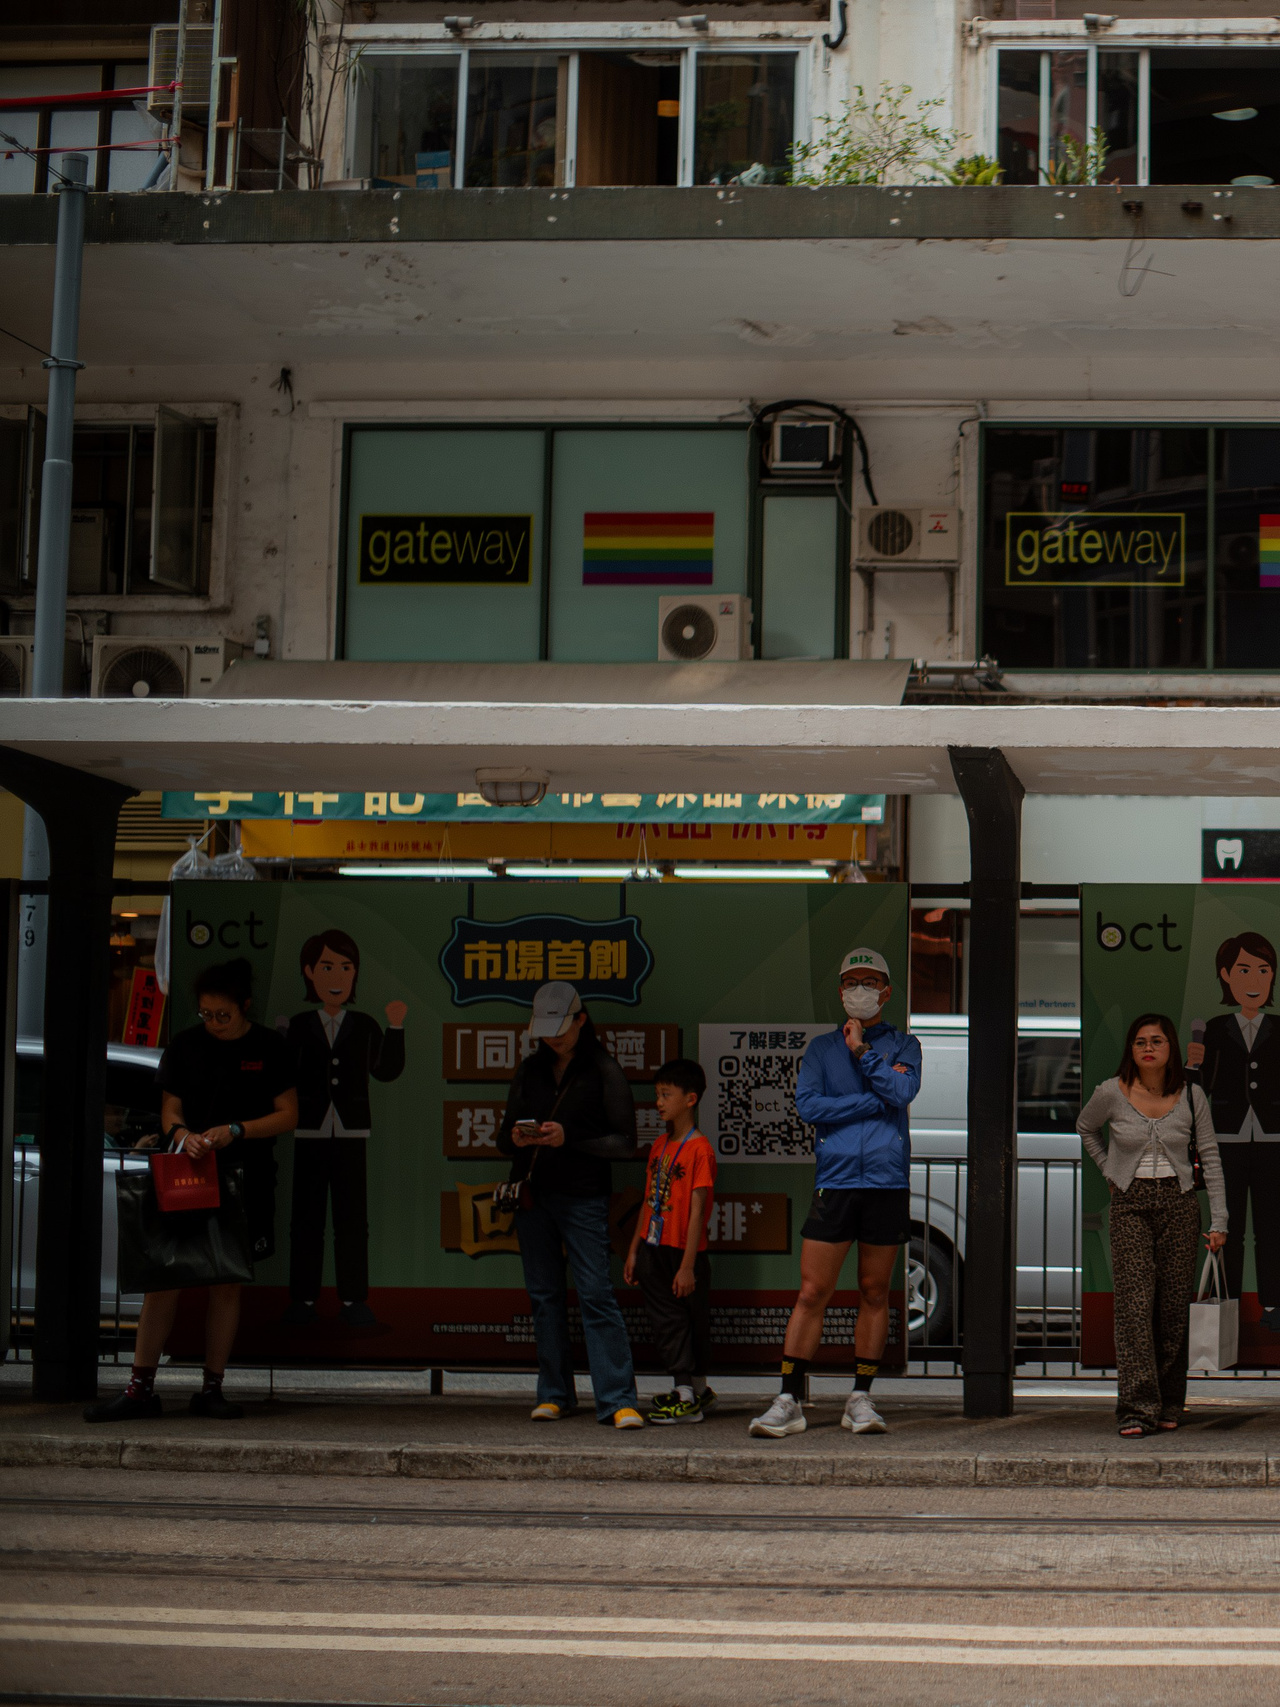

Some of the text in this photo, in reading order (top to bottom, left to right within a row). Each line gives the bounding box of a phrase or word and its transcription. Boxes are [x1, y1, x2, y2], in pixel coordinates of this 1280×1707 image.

[368, 520, 527, 577] gateway
[1016, 520, 1178, 576] gateway
[186, 909, 269, 949] bct
[1097, 911, 1183, 952] bct
[463, 939, 628, 982] 市場首創
[1038, 999, 1076, 1009] Partners
[729, 1031, 807, 1050] 了解更多
[754, 1099, 781, 1113] bct
